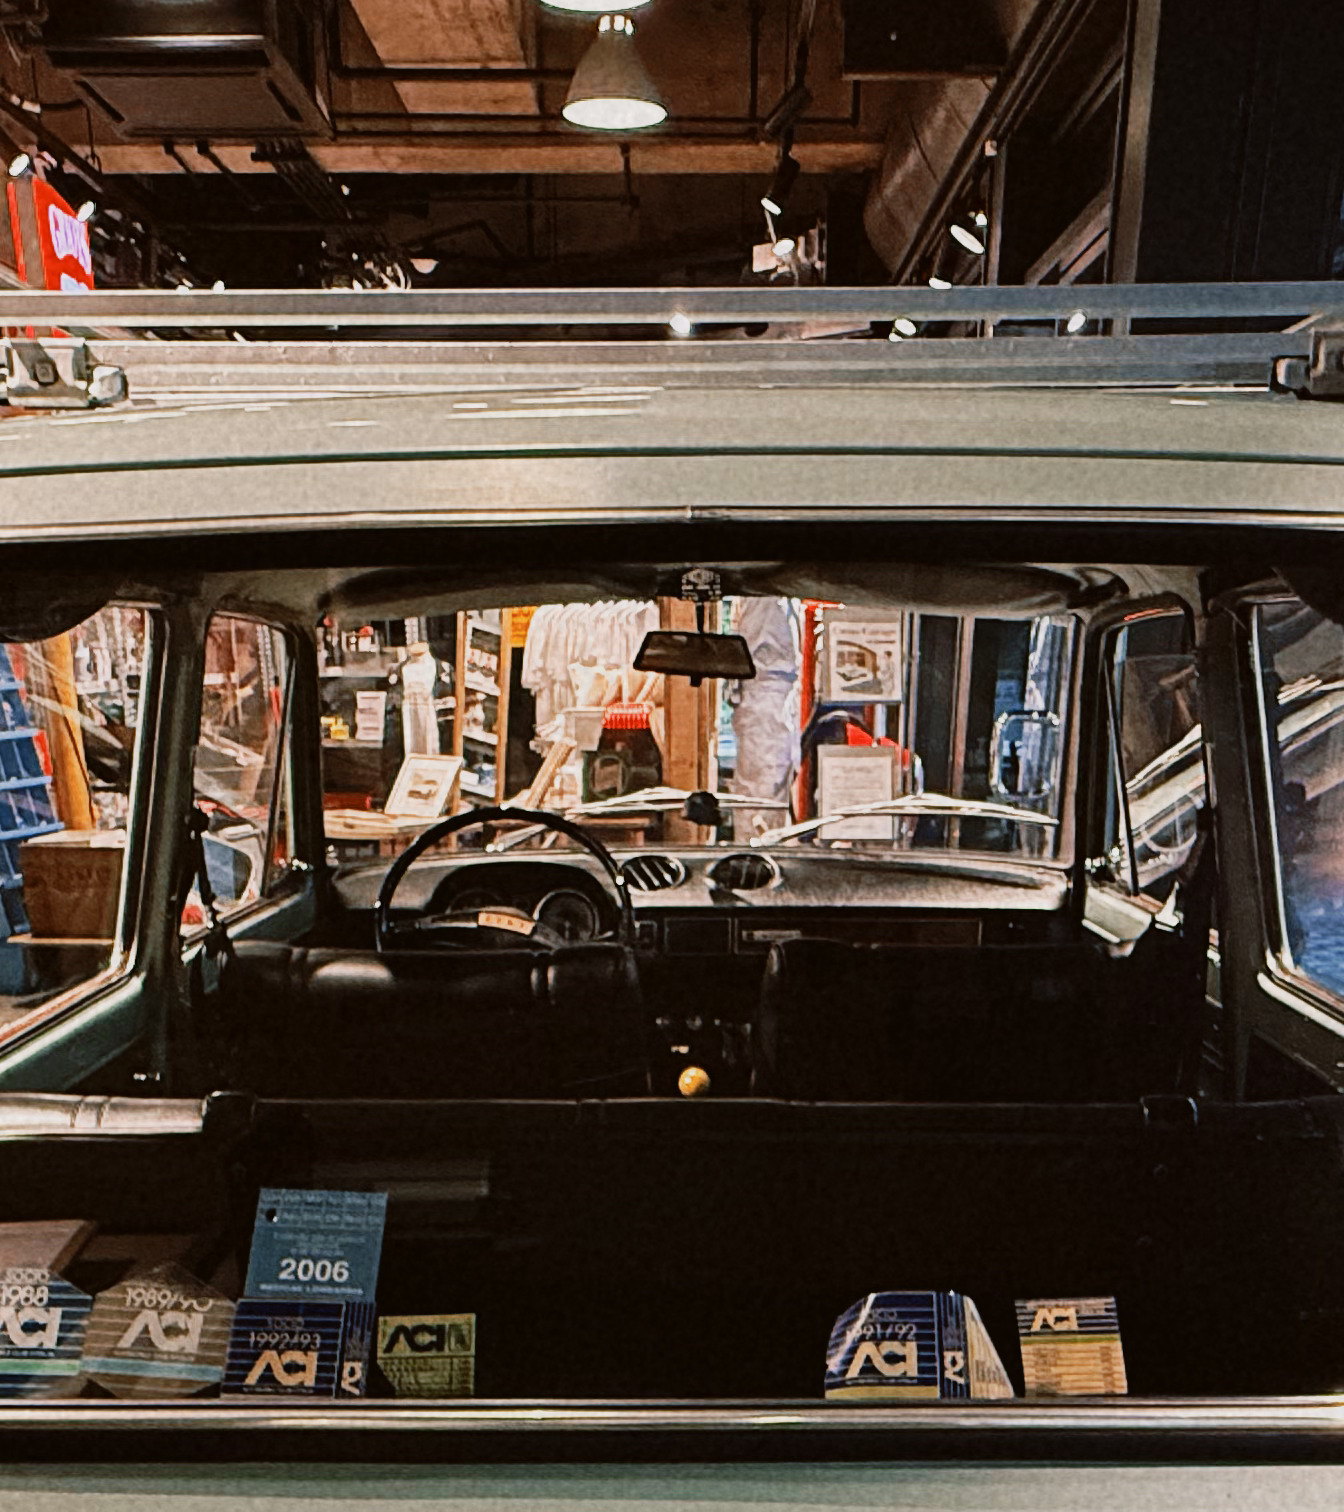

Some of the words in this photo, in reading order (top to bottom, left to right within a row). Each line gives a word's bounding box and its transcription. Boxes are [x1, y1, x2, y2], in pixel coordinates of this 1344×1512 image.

[278, 1257, 350, 1283] 2006
[1, 1284, 50, 1308] 1988
[116, 1308, 204, 1354] ACI
[1030, 1306, 1079, 1332] ACI
[383, 1323, 447, 1355] ACI
[243, 1350, 319, 1387] ACI
[845, 1340, 918, 1379] ACI
